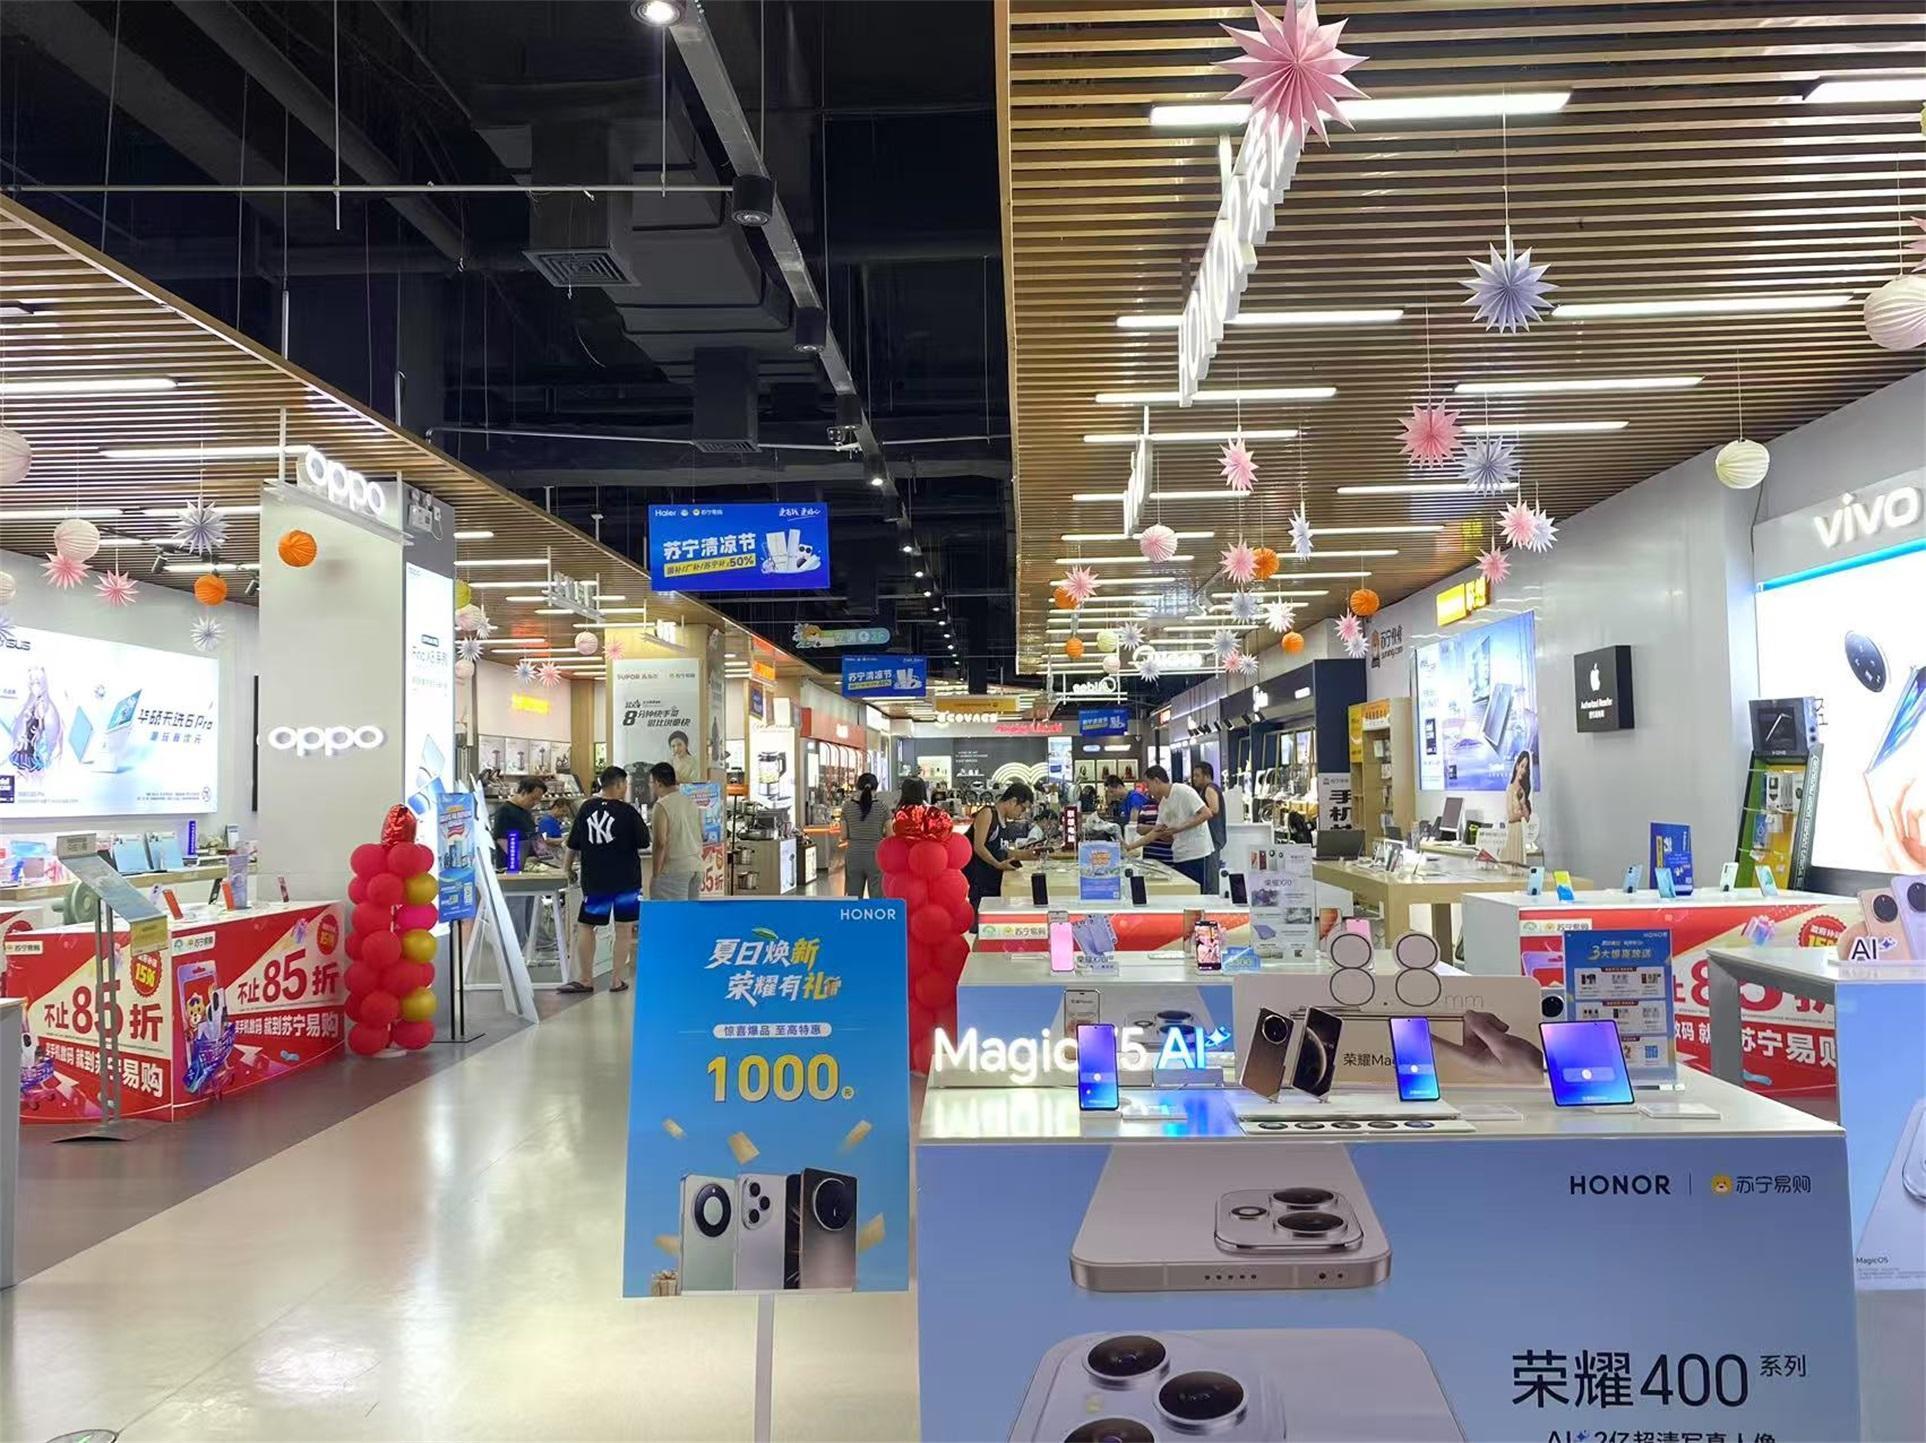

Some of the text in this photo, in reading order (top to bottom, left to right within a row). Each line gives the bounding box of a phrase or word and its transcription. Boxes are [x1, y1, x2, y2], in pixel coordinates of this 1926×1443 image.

[305, 448, 386, 516] oppo
[655, 509, 677, 517] Haier
[1814, 486, 1921, 548] vivo
[663, 533, 756, 560] 苏宁清凉节
[194, 715, 213, 730] Pro
[268, 725, 385, 757] oppo
[840, 908, 896, 921] HONOR
[705, 938, 820, 970] 夏日焕新
[1851, 939, 1877, 960] AI
[238, 949, 339, 1005] 不止85折
[44, 979, 164, 1042] 不止85折
[263, 1013, 339, 1038] 就到苏宁易购
[723, 1024, 821, 1037] 惊喜爆品 至高特惠
[933, 1027, 1078, 1084] Magic
[1157, 1027, 1206, 1070] AI
[706, 1052, 840, 1102] 1000
[1570, 1175, 1671, 1196] HONOR
[1736, 1175, 1812, 1195] 苏宁易购
[1856, 1256, 1889, 1266] MagicOS
[1512, 1349, 1807, 1409] 荣耀400 系列
